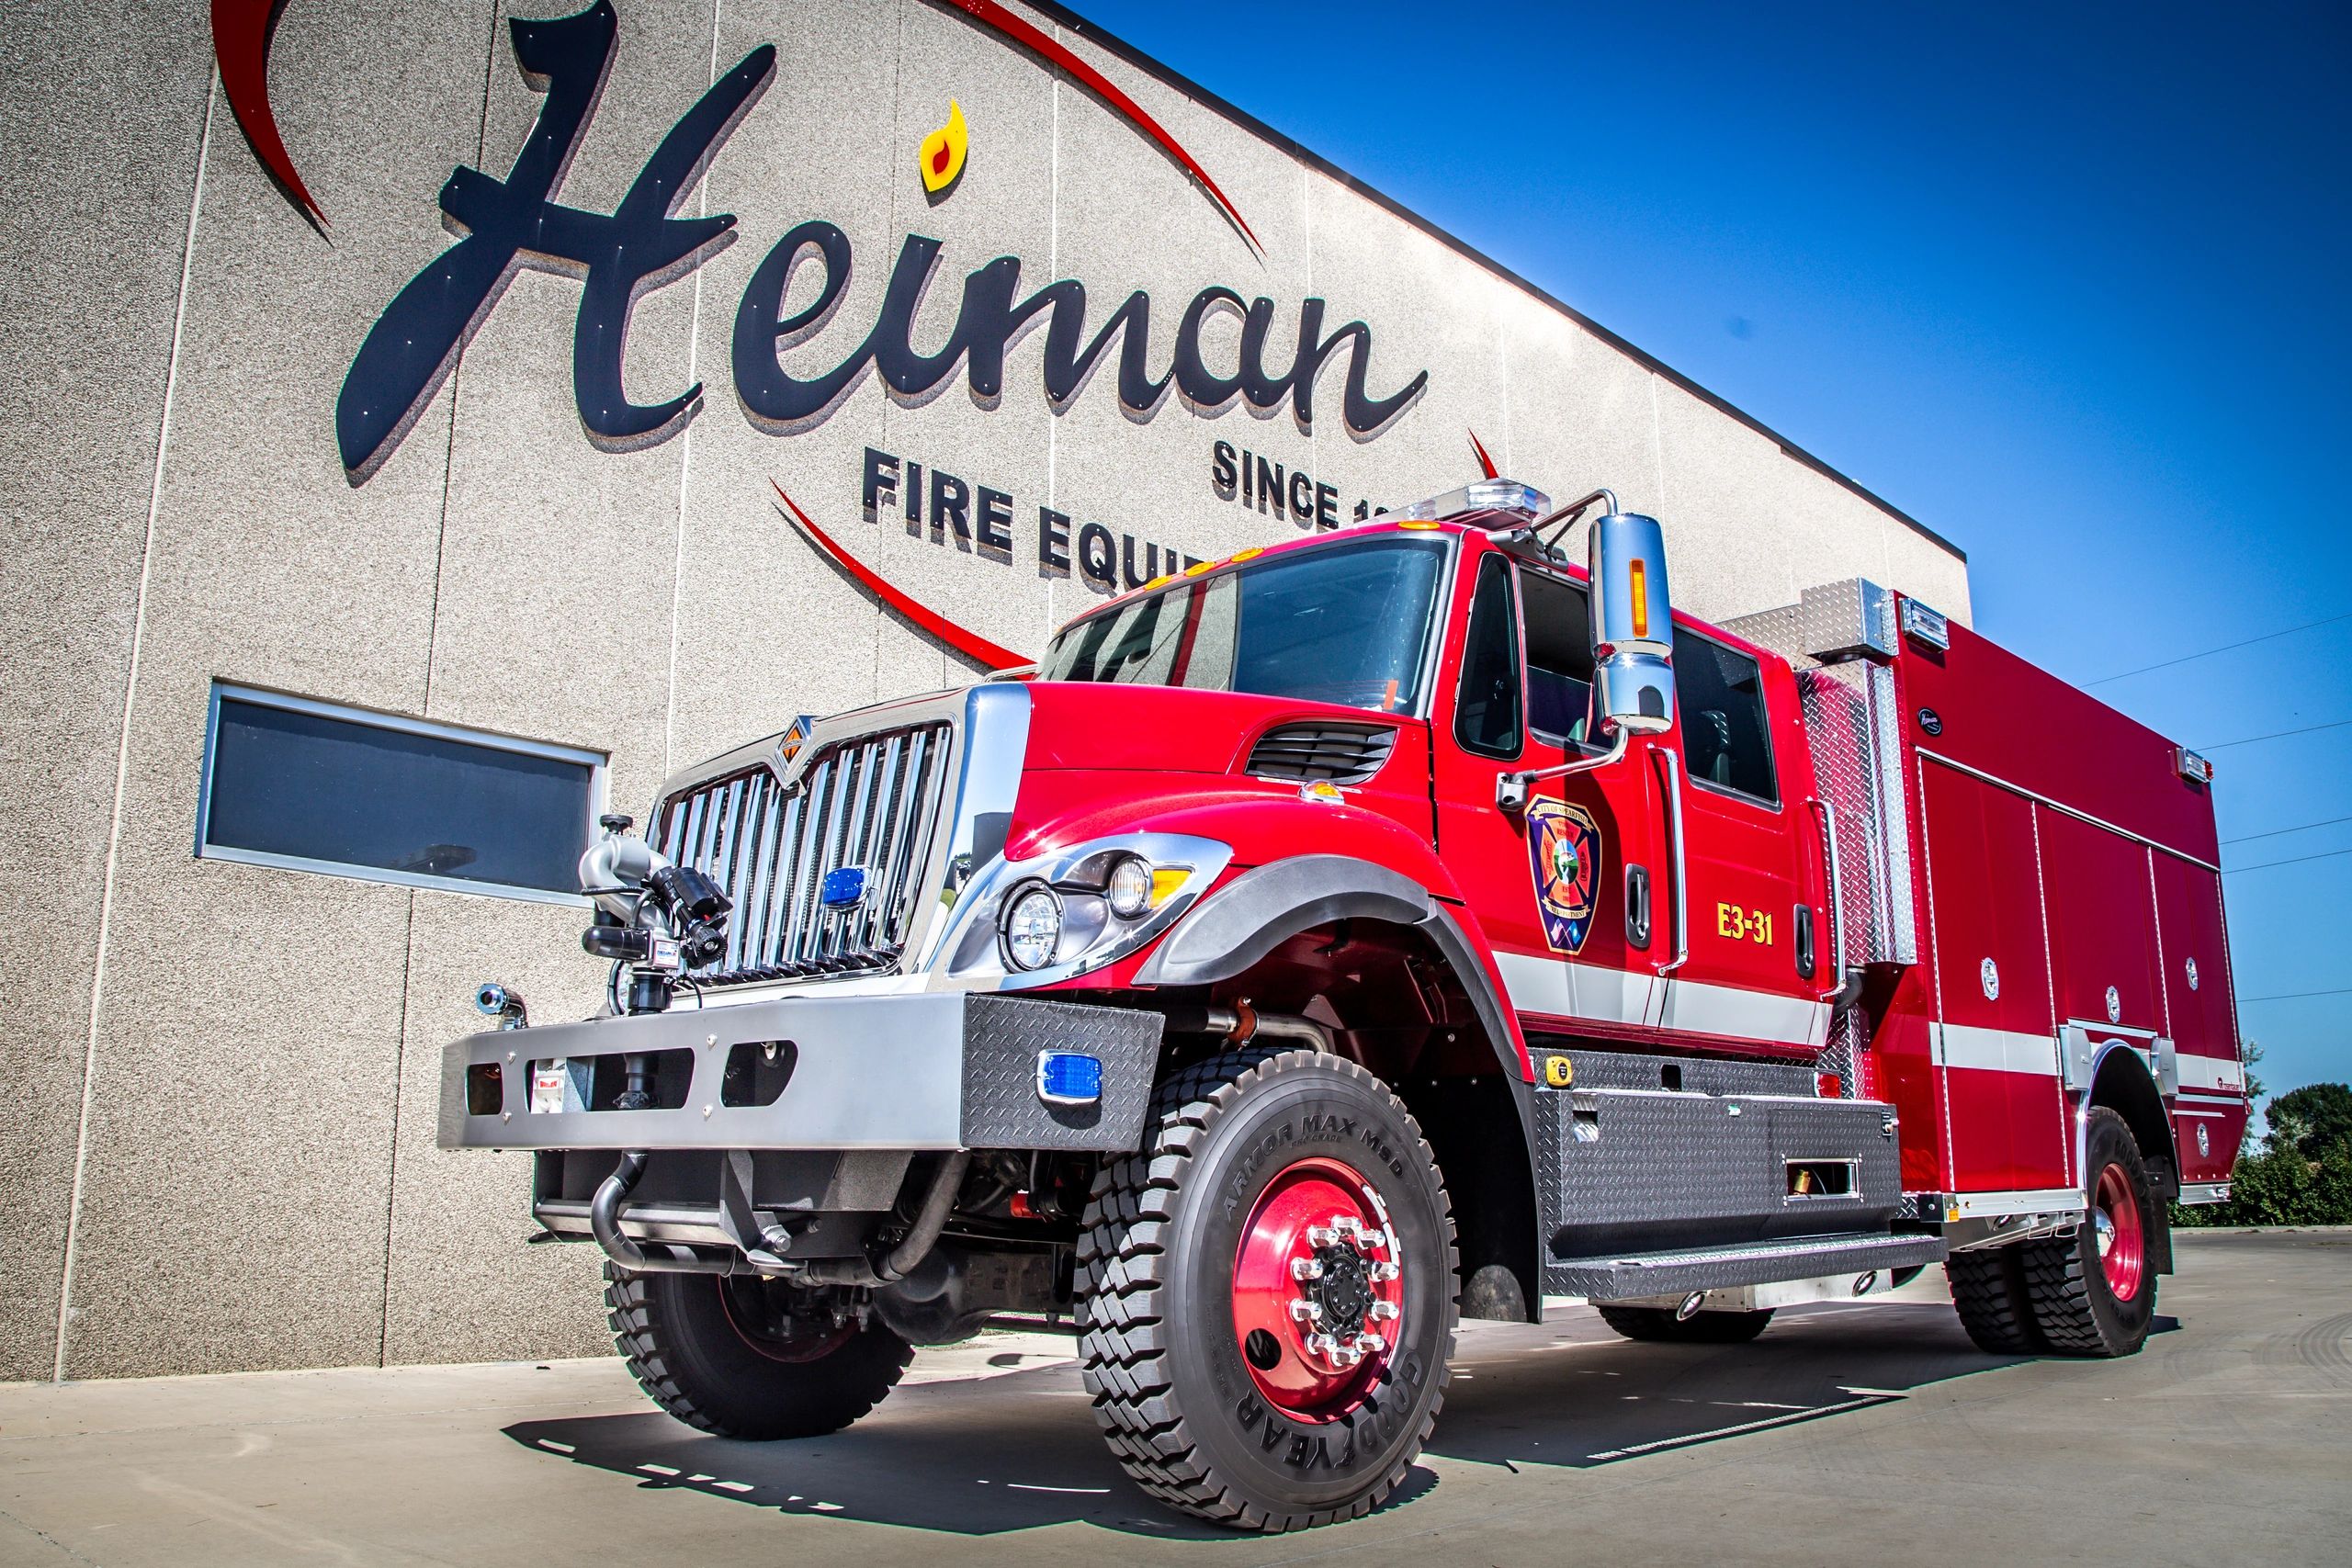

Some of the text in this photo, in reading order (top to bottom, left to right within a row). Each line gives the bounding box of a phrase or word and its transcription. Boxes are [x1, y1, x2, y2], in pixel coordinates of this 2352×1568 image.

[336, 0, 1428, 470] Heiman
[863, 446, 1205, 590] FIRE EQUI
[1212, 440, 1339, 530] SINCE
[1537, 805, 1550, 813] CITY
[1559, 807, 1589, 825] SPEARFISH
[1717, 901, 1773, 947] E3-31
[1224, 1113, 1404, 1223] ARMOR MAX MSD
[1235, 1350, 1423, 1470] GOODYEAR
